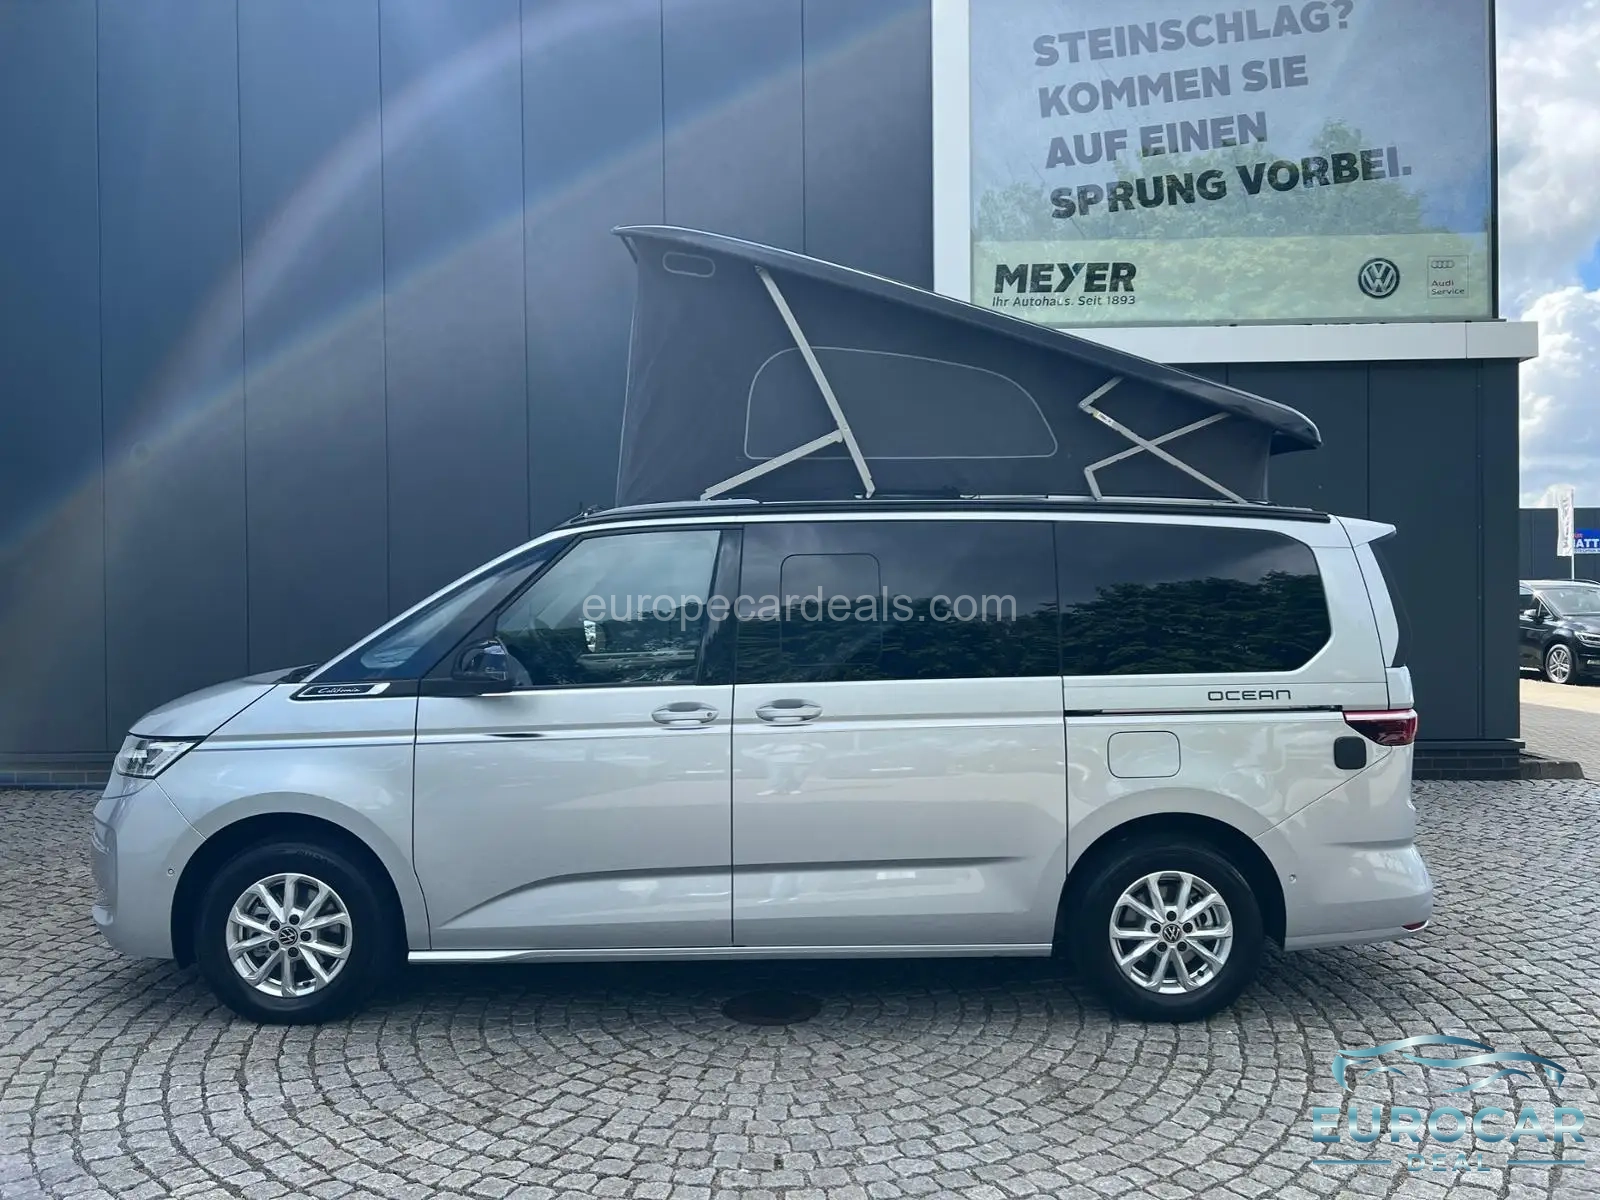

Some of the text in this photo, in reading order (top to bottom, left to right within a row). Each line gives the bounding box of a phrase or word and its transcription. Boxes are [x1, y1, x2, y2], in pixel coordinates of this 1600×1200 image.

[1033, 0, 1354, 67] STEINSCHLAG?
[1038, 55, 1309, 118] KOMMEN SIE
[1045, 111, 1267, 169] AUF EINEN
[1050, 146, 1412, 219] SPRUNG VORBEI.
[994, 262, 1137, 294] MEYER
[1431, 279, 1455, 287] Audi
[1431, 287, 1465, 296] Service
[992, 296, 1009, 307] Ihr
[1078, 295, 1103, 306] Seit
[1106, 294, 1136, 305] 1893
[1207, 689, 1292, 701] OCEAN
